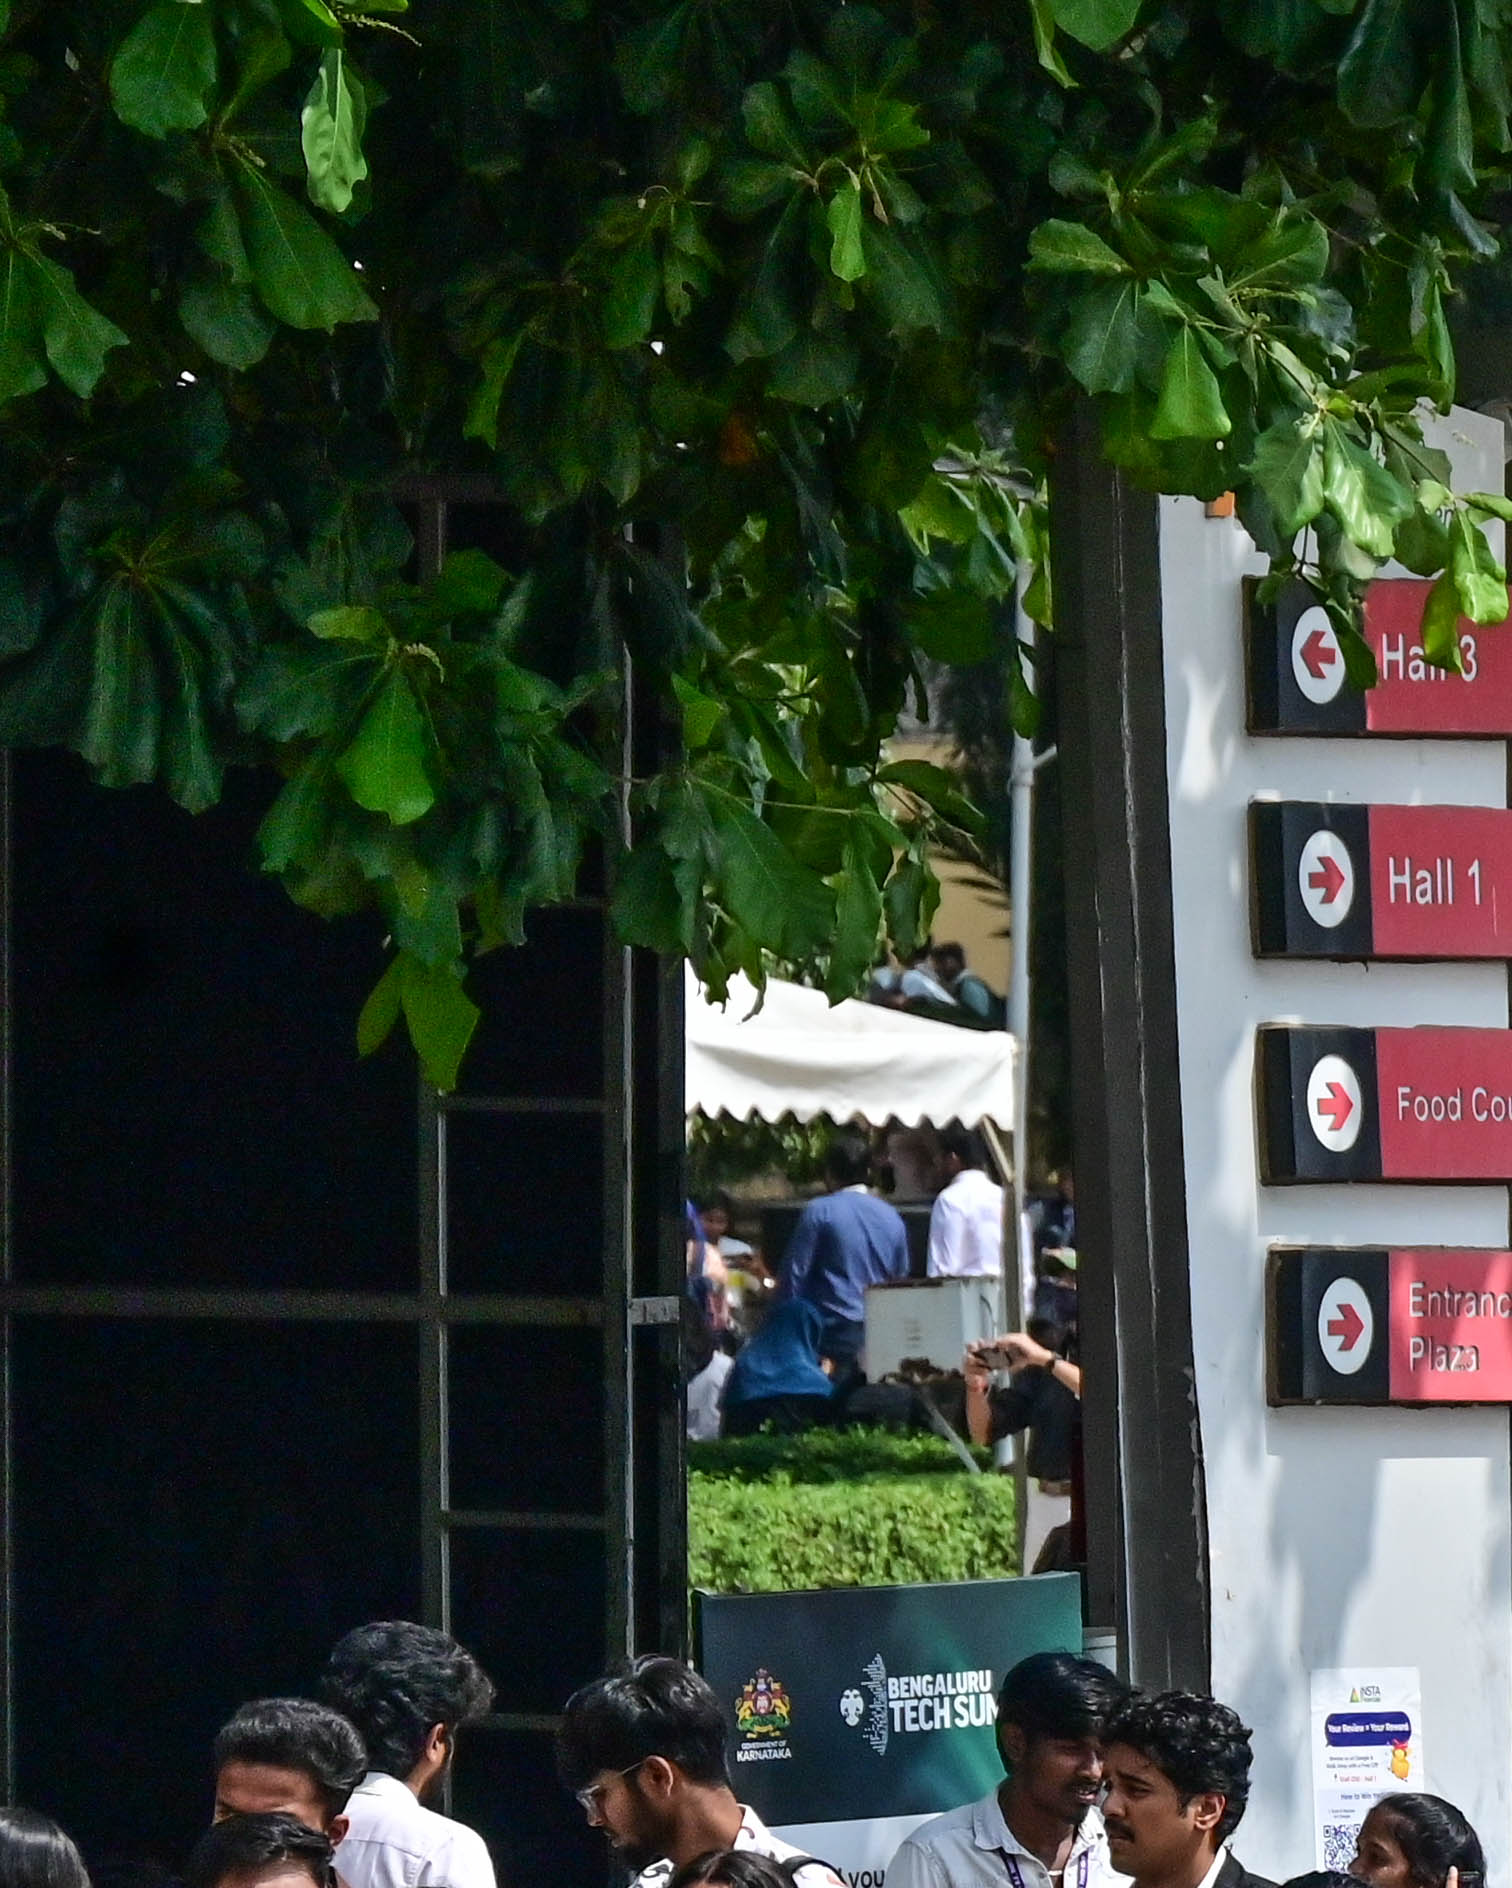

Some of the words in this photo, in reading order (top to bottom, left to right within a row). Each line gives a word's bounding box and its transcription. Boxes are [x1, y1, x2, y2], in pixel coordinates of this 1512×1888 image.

[1381, 633, 1447, 682] Ha
[1459, 634, 1479, 682] 3
[1388, 857, 1454, 906] Hall
[1467, 858, 1482, 906] 1
[1397, 1086, 1463, 1122] Food
[1409, 1335, 1480, 1373] Plaza
[887, 1669, 992, 1699] BENGALURU
[888, 1698, 950, 1733] TECH
[953, 1692, 1000, 1730] SUM
[736, 1748, 793, 1762] KARNATAKA
[741, 1741, 779, 1750] GOVERNMENT
